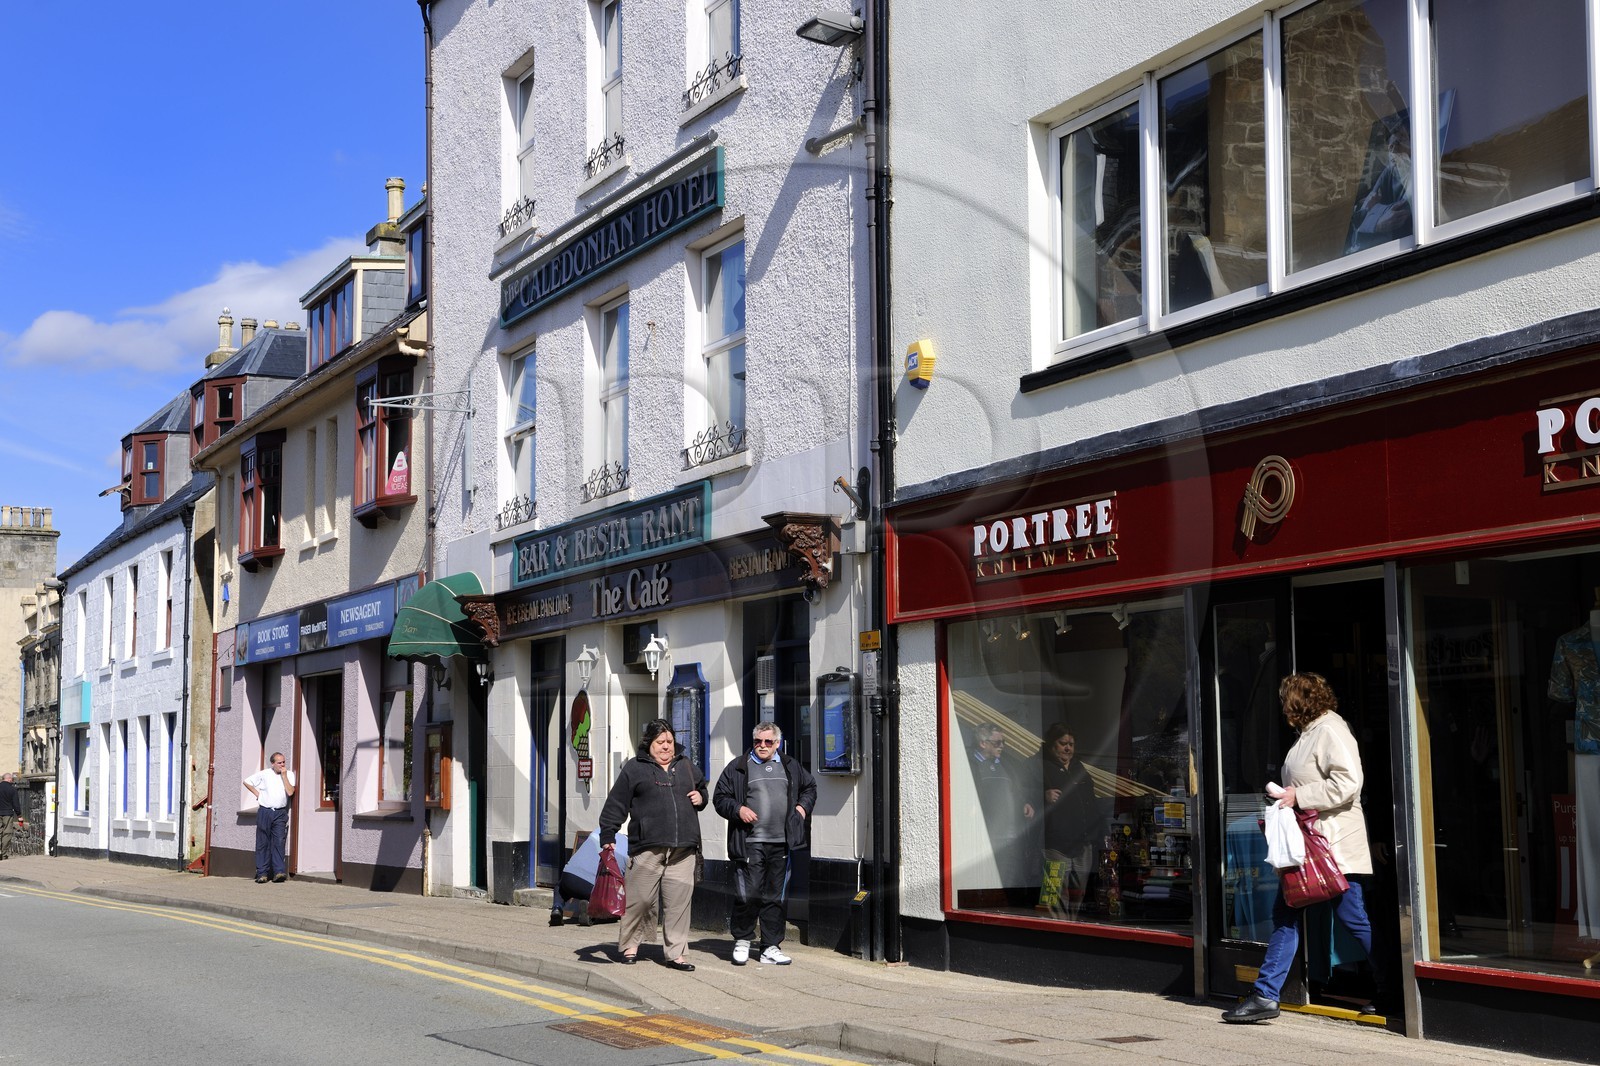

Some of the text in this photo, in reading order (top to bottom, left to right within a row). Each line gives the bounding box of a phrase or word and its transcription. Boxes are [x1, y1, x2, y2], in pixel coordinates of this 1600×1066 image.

[520, 211, 635, 307] CALEDONIAN
[642, 165, 717, 237] HOTEL
[973, 499, 1113, 557] PORTREE
[518, 539, 549, 577] BAR
[554, 534, 568, 567] &
[977, 540, 1118, 578] KNITWEAR
[590, 561, 669, 619] The Café
[340, 601, 381, 624] NEWSAGENT
[257, 624, 290, 644] BOOK STORE
[1553, 800, 1577, 814] Pure
